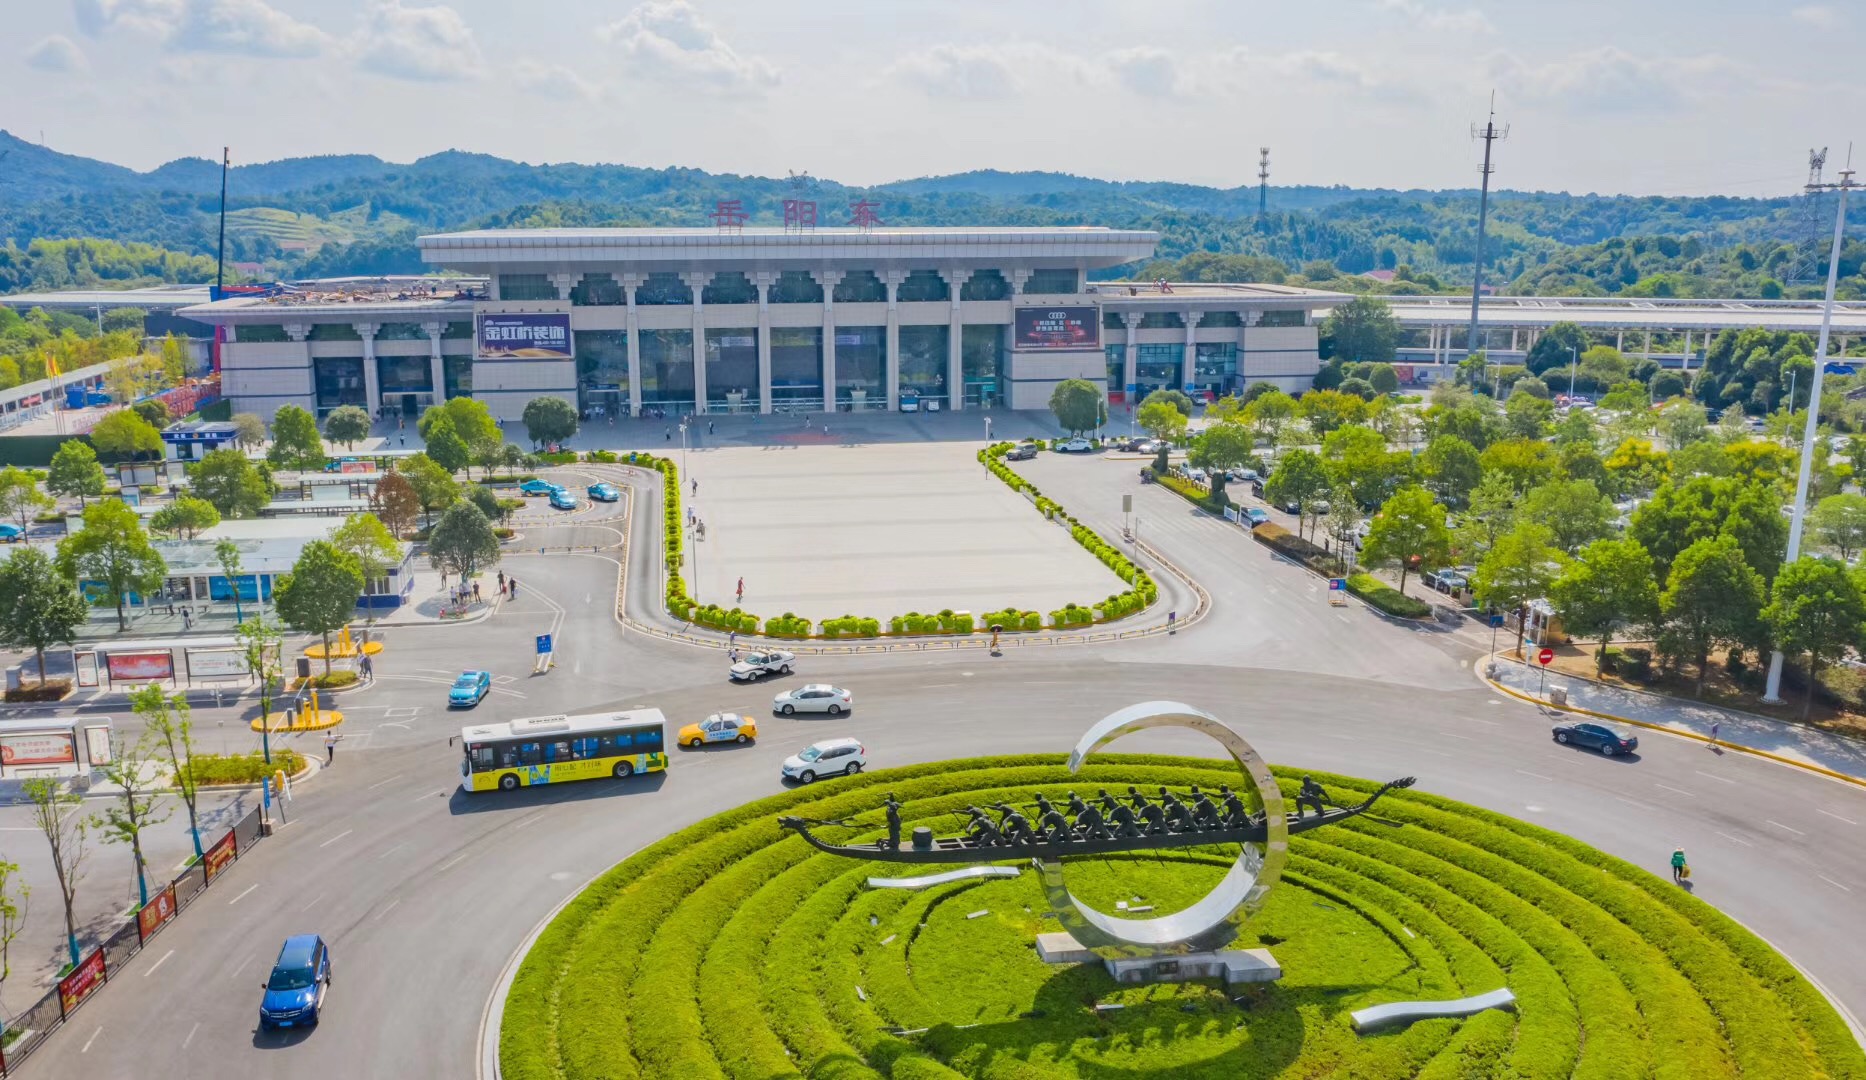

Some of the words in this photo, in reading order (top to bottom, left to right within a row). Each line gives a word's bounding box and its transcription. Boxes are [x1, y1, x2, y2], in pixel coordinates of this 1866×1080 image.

[708, 199, 885, 227] 岳阳东
[485, 326, 565, 340] 金虹桥装饰
